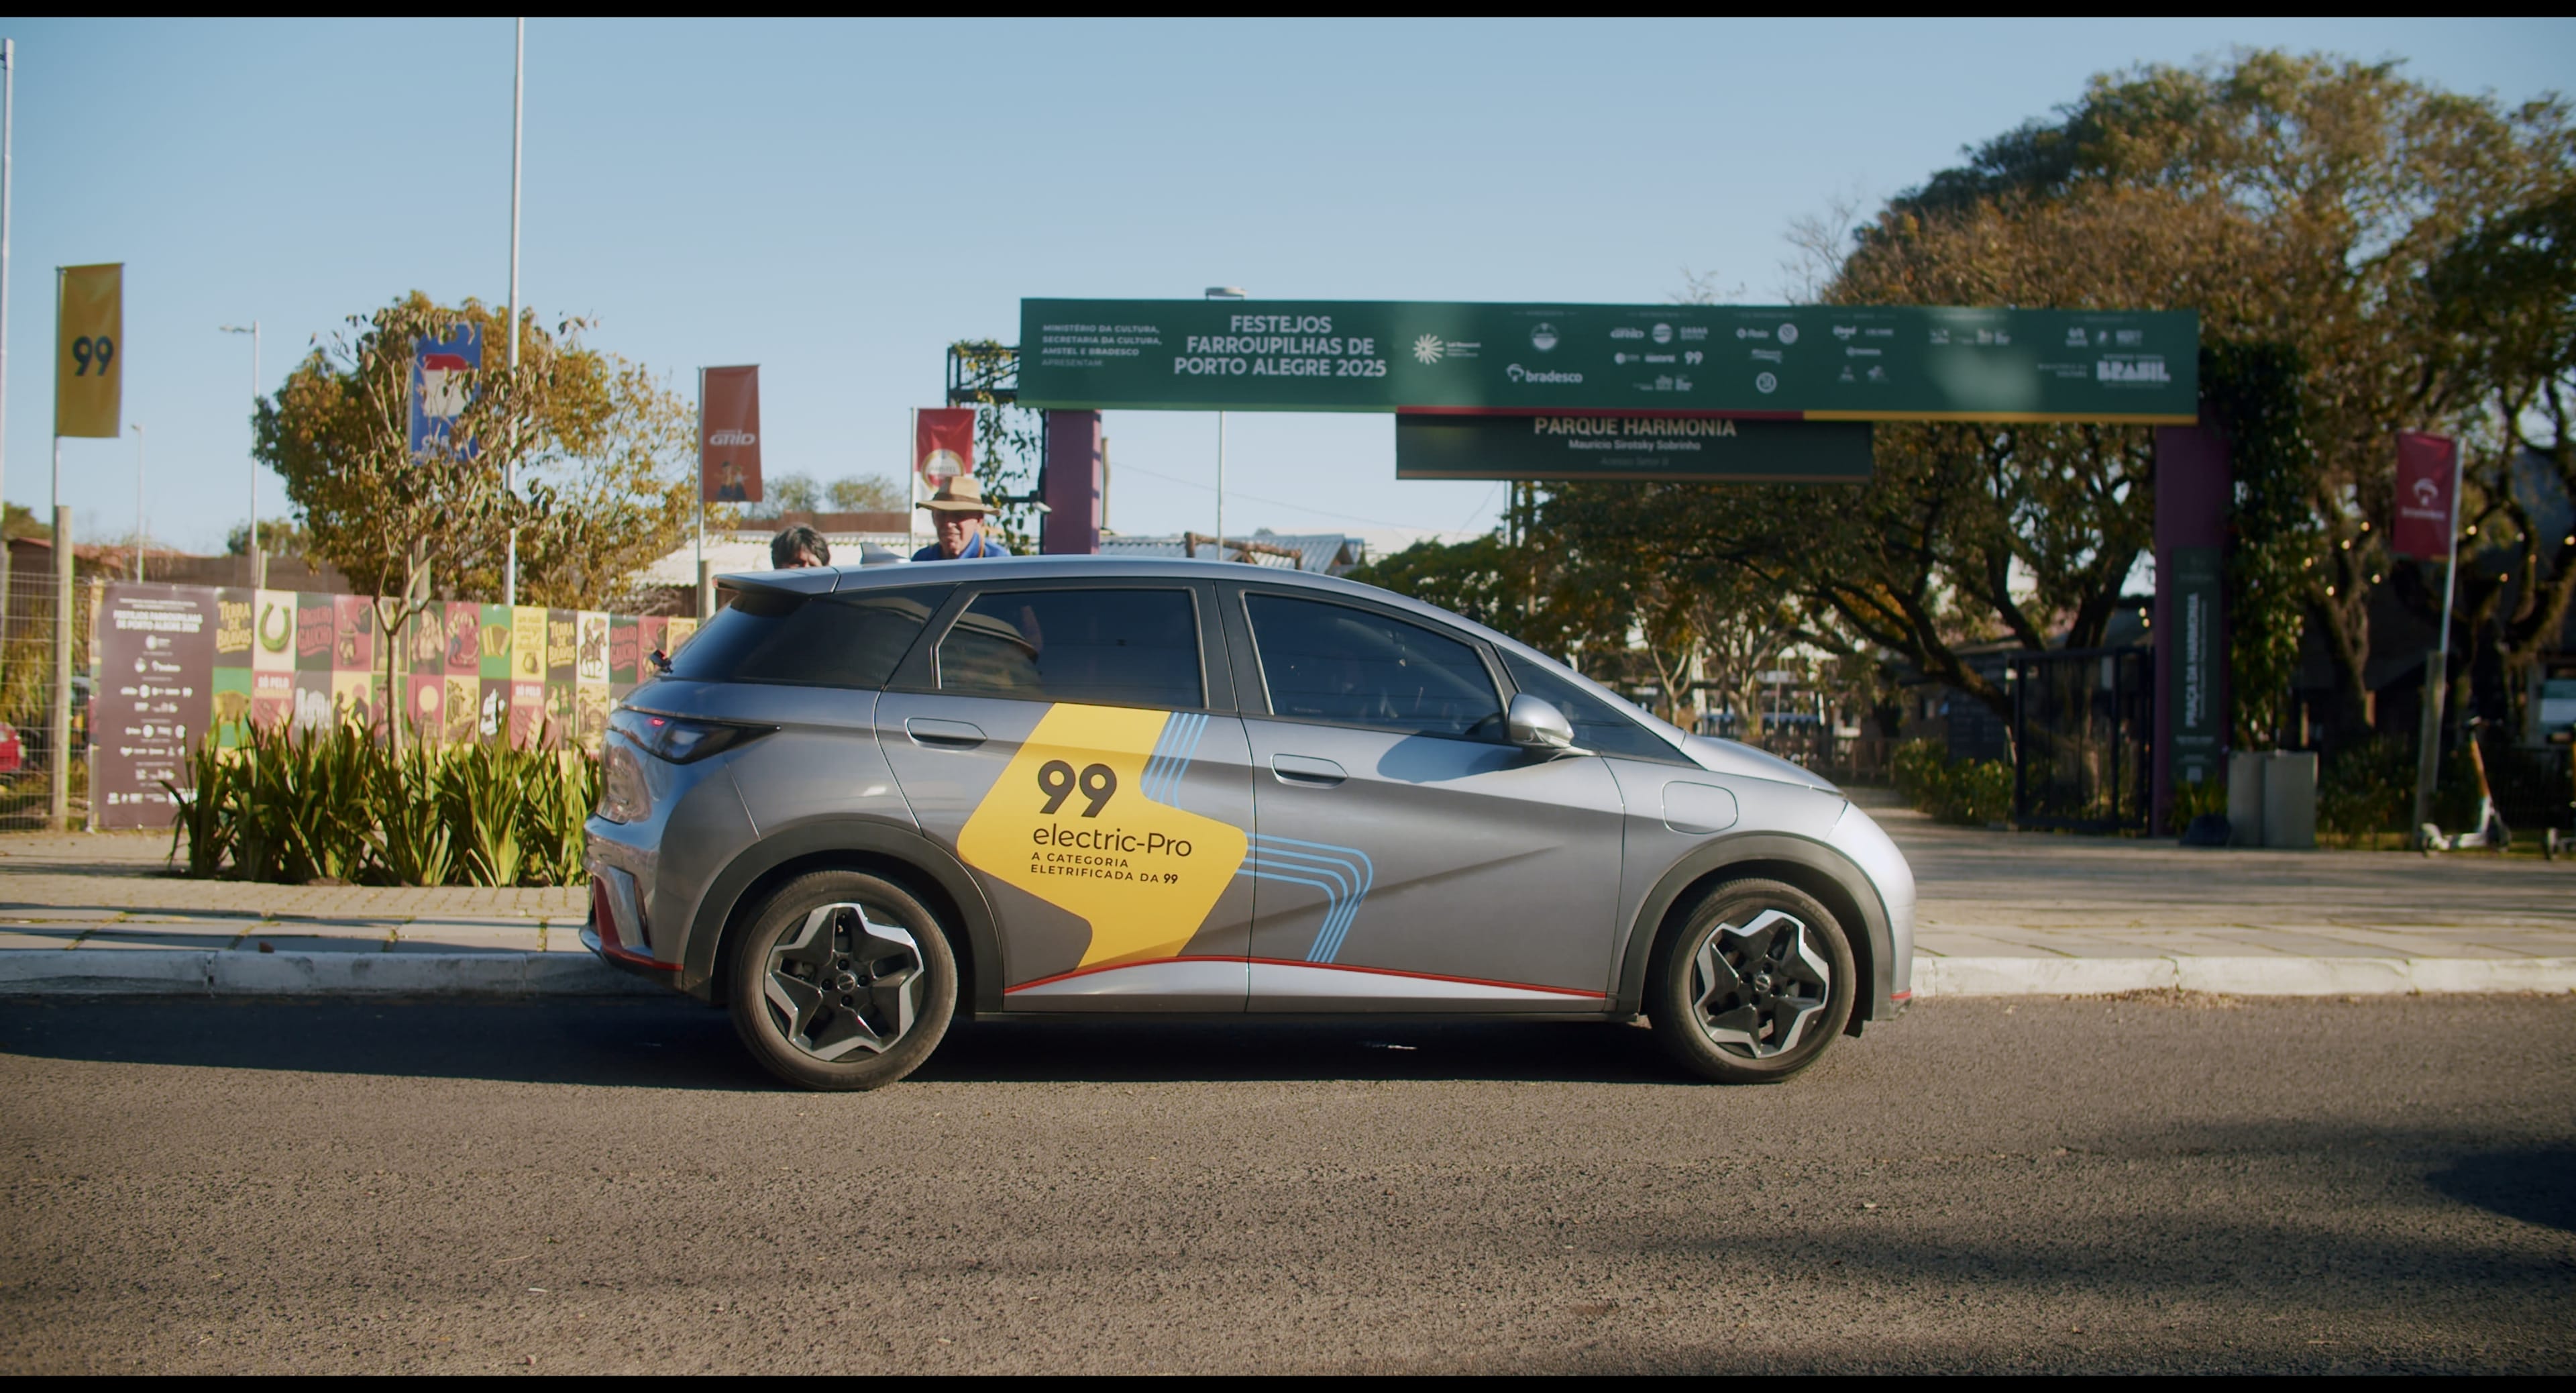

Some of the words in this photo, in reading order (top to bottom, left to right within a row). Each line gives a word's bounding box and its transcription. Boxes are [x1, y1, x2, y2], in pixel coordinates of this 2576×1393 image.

[1098, 325, 1112, 333] DA
[1230, 315, 1332, 334] FESTEJOS
[1042, 335, 1099, 344] SECRETARIA
[1187, 336, 1343, 355] FARROUPILHAS
[1348, 338, 1375, 355] DE
[72, 336, 114, 376] 99
[1042, 347, 1078, 356] AMSTEL
[1079, 348, 1086, 356] E
[1088, 348, 1140, 356] BRADESCO
[1684, 350, 1704, 365] 99
[1174, 356, 1247, 375] PORTO
[1252, 358, 1331, 376] ALEGRE
[1335, 359, 1387, 378] 2025
[1525, 369, 1583, 384] bradesco
[1534, 417, 1619, 435] PARQUE
[1623, 418, 1737, 436] HARMONIA
[1613, 440, 1654, 452] Sirotsky
[1656, 440, 1701, 451] Sobrinho
[217, 601, 252, 624] TERRA
[548, 619, 575, 639] TERRA
[215, 629, 253, 649] BRAVOS
[548, 644, 576, 663] BRAVOS
[258, 674, 268, 688] SÓ
[269, 677, 289, 688] PELO
[1037, 760, 1118, 819] 99
[1032, 823, 1192, 858] electric-Pro
[1031, 852, 1040, 861] A
[1046, 853, 1128, 868] CATEGORIA
[1030, 864, 1134, 881] ELETRIFICADA
[1139, 872, 1159, 884] DA
[1163, 873, 1179, 885] 99
